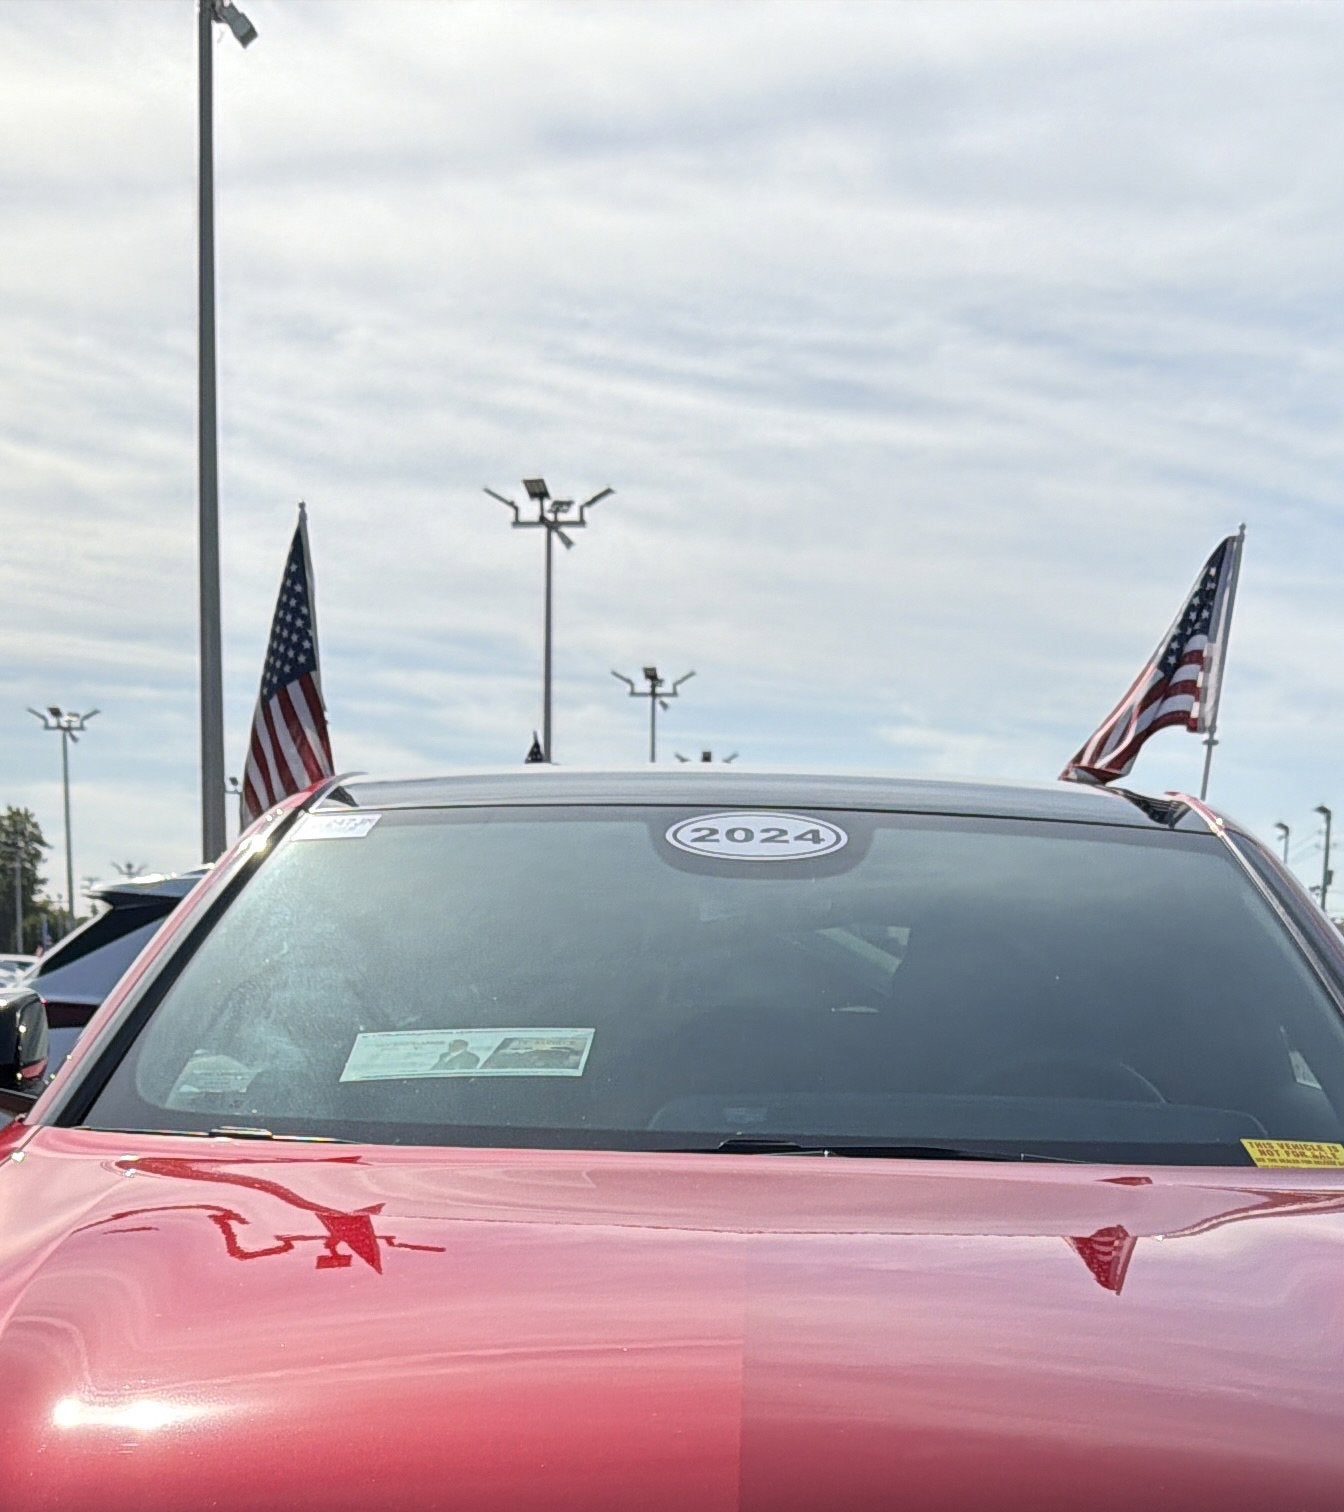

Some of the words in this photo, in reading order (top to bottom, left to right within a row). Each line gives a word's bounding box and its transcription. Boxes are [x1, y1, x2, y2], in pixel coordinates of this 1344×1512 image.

[689, 827, 826, 845] 2024
[1247, 1141, 1275, 1150] THIS
[1276, 1142, 1325, 1152] VEHICLE
[1327, 1145, 1340, 1154] IS
[1257, 1149, 1281, 1157] NOT
[1284, 1150, 1307, 1158] FOR
